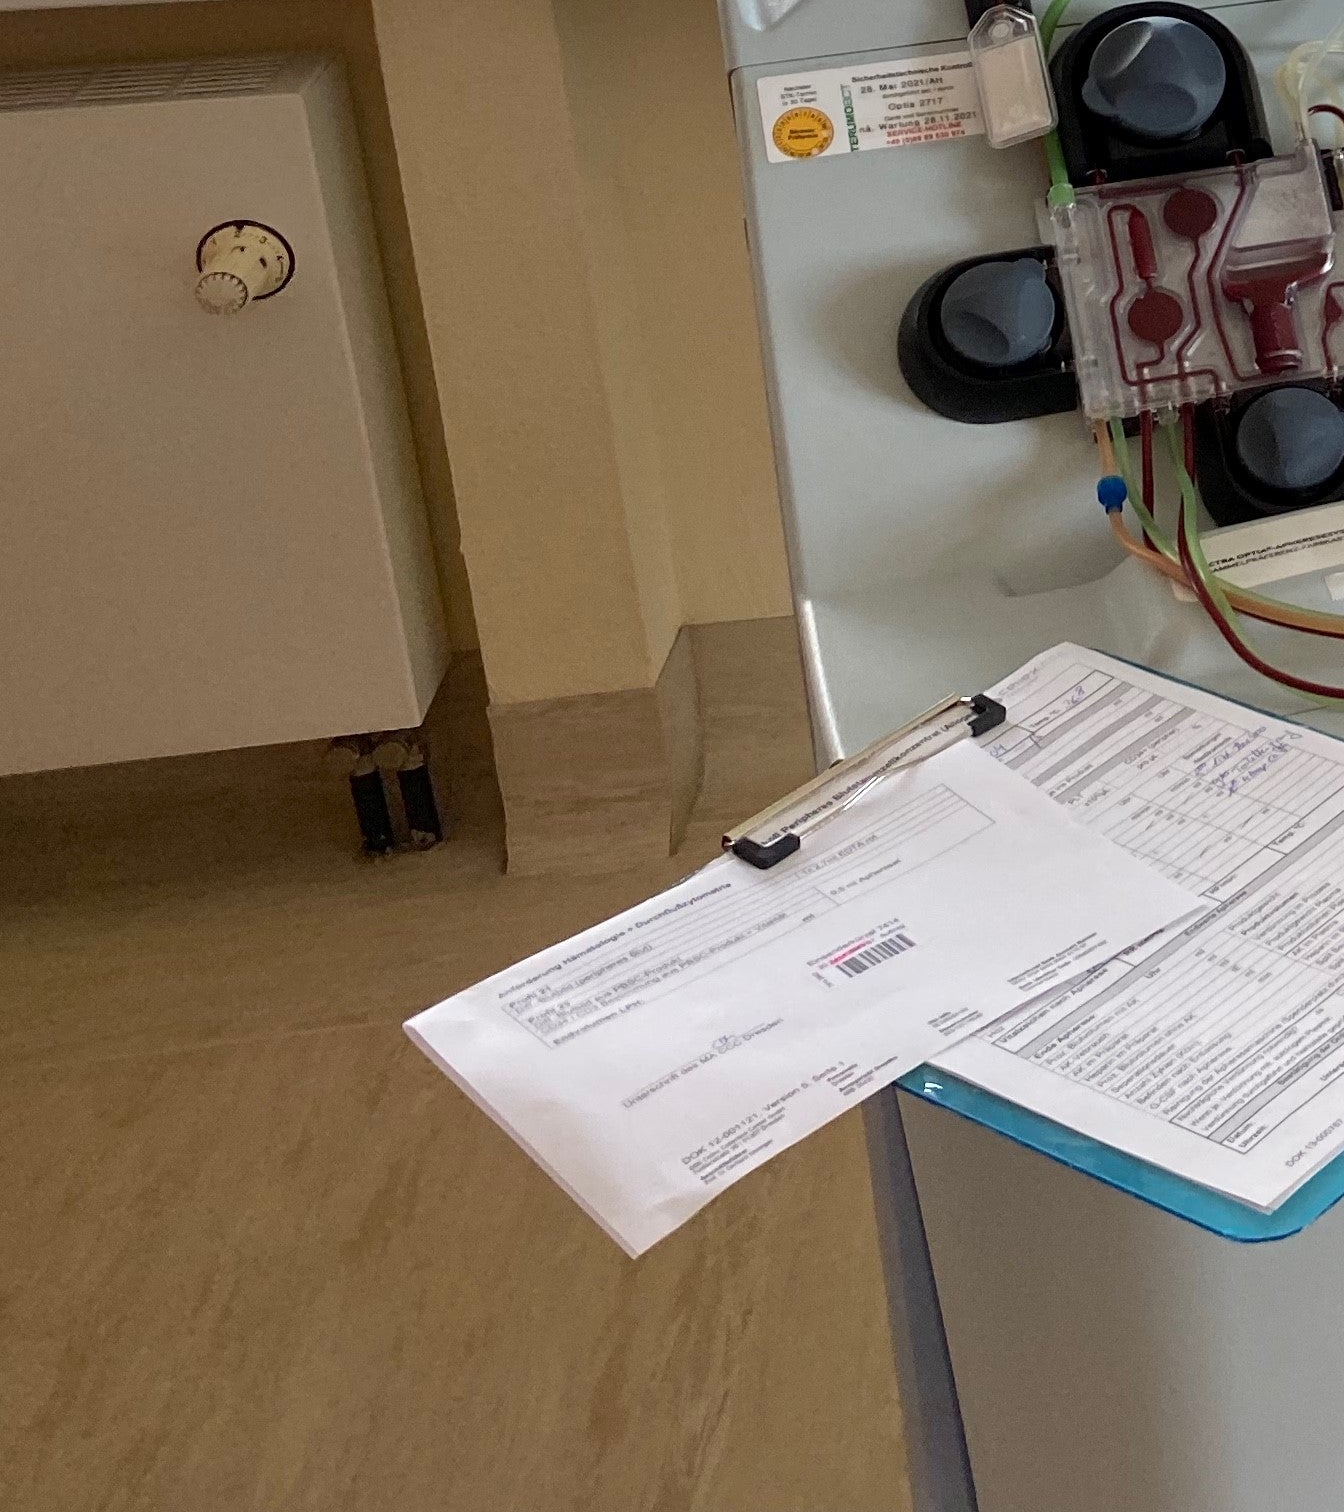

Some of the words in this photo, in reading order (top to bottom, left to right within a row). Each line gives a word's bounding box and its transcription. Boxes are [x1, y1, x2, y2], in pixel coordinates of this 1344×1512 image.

[888, 102, 915, 111] Optia
[920, 97, 943, 107] 2717
[878, 120, 920, 130] Wartung
[623, 1073, 679, 1108] Unterschrift
[681, 1063, 698, 1075] des
[742, 1019, 783, 1041] Dresden
[682, 1146, 707, 1165] DOK
[764, 1088, 800, 1111] Version
[812, 1066, 837, 1082] Seite
[1285, 1150, 1306, 1167] DOK
